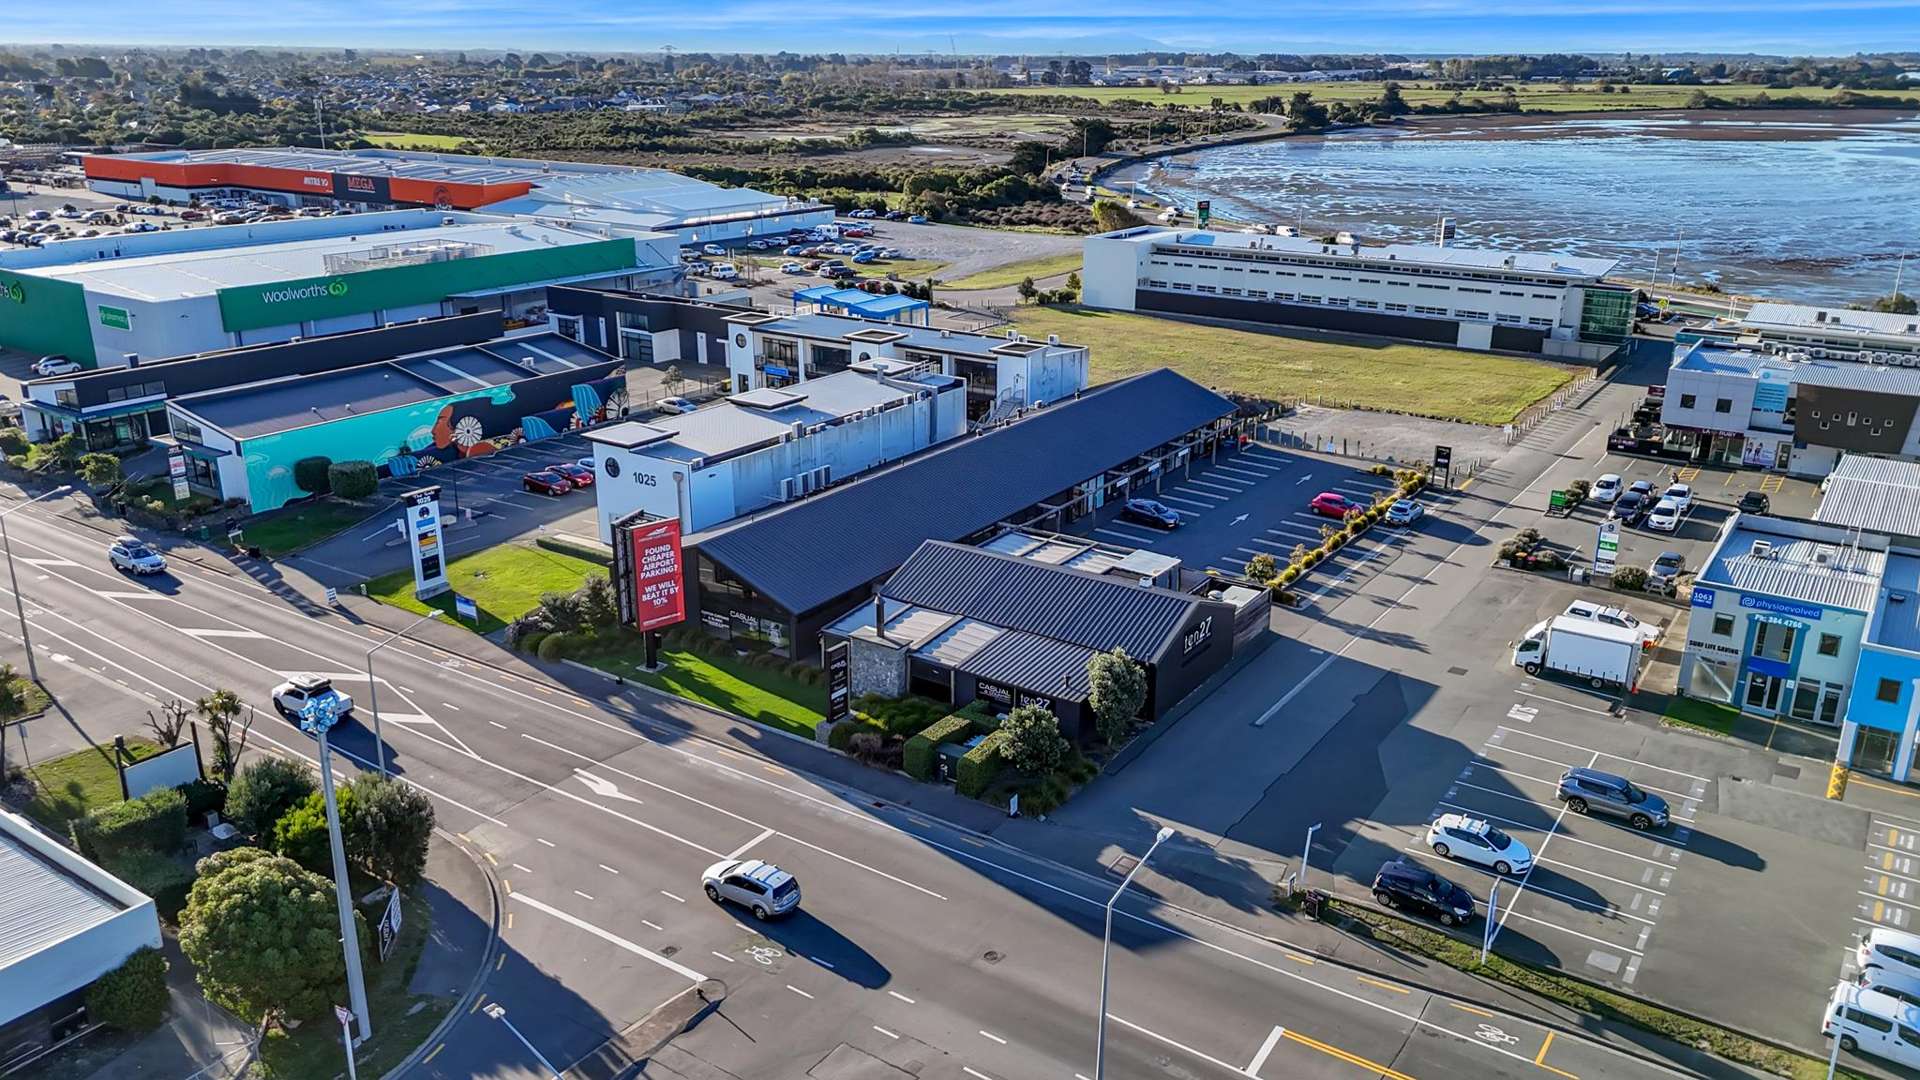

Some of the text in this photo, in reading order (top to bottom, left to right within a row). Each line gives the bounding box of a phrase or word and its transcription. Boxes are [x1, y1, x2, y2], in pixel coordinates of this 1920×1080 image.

[346, 176, 375, 190] MEGA
[262, 283, 328, 304] Woolworths
[632, 471, 657, 487] 1025
[641, 550, 675, 565] CHEAPER
[644, 543, 671, 557] FOUND
[640, 564, 678, 580] PARKING?
[642, 557, 675, 572] AIRPORT
[642, 585, 680, 602] BEAT IT BY
[644, 579, 676, 594] WE WILL
[652, 597, 668, 607] 10%
[1756, 599, 1821, 618] physioevolved
[729, 609, 758, 623] CASUAL
[1184, 615, 1212, 649] ten27
[1704, 642, 1717, 650] LIFE
[1717, 644, 1740, 655] SAVING
[978, 682, 1010, 696] CASUAL
[1020, 693, 1051, 710] ten27
